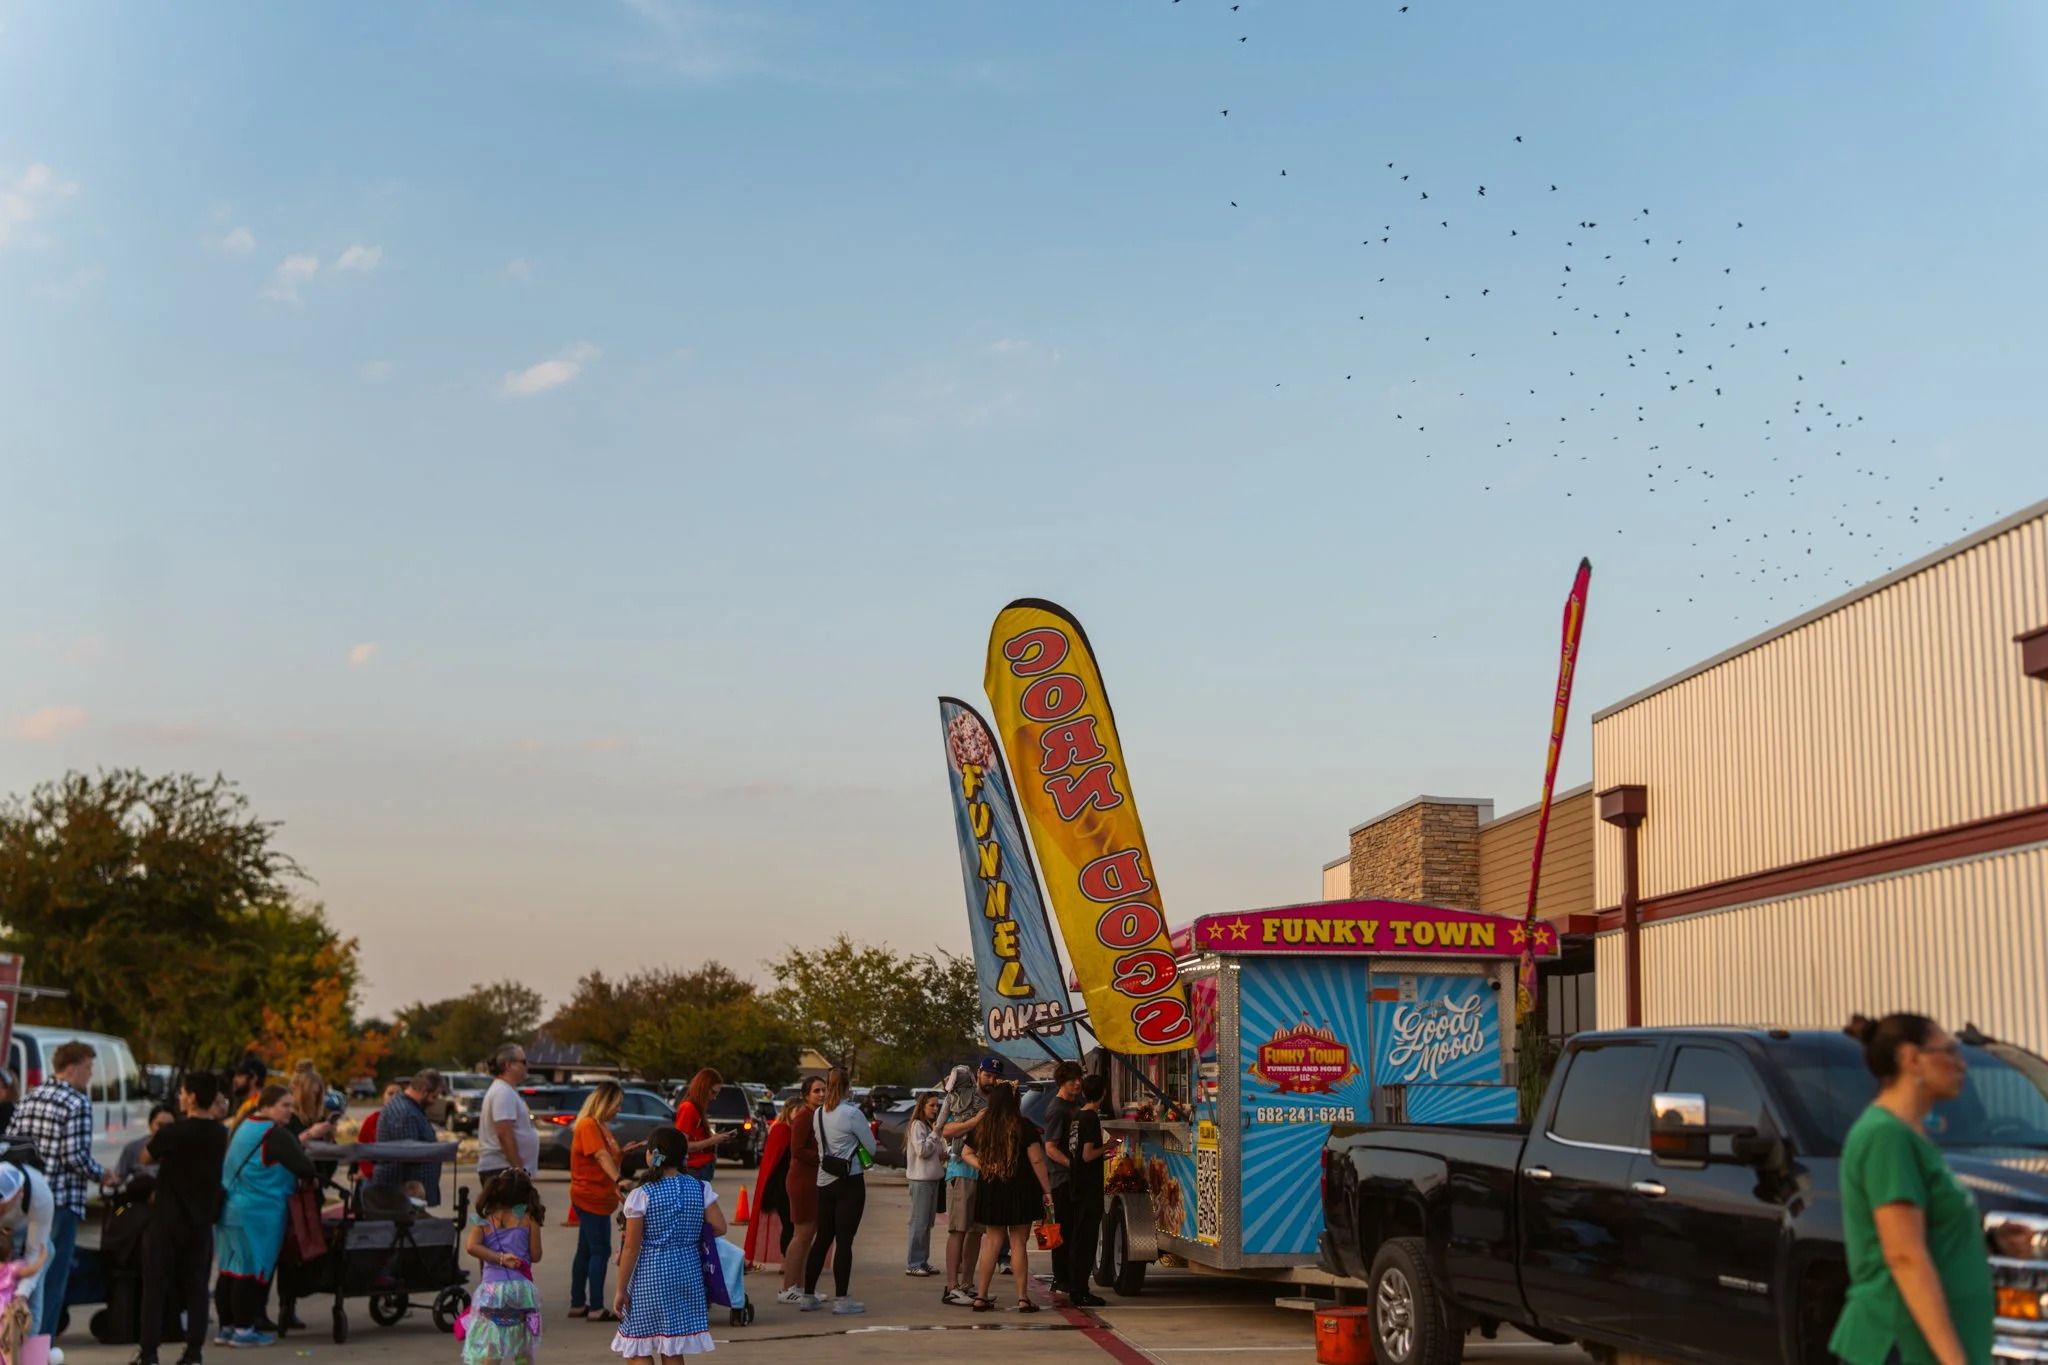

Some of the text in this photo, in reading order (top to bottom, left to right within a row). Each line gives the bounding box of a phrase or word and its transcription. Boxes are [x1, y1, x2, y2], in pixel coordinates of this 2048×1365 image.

[961, 761, 1035, 999] FUNNEL
[1262, 918, 1496, 948] FUNKY TOWN
[987, 1001, 1065, 1042] CAKES
[1389, 994, 1482, 1066] Good
[1264, 1047, 1345, 1064] FUNKY TOWN
[1257, 1107, 1355, 1124] 682-241-6245
